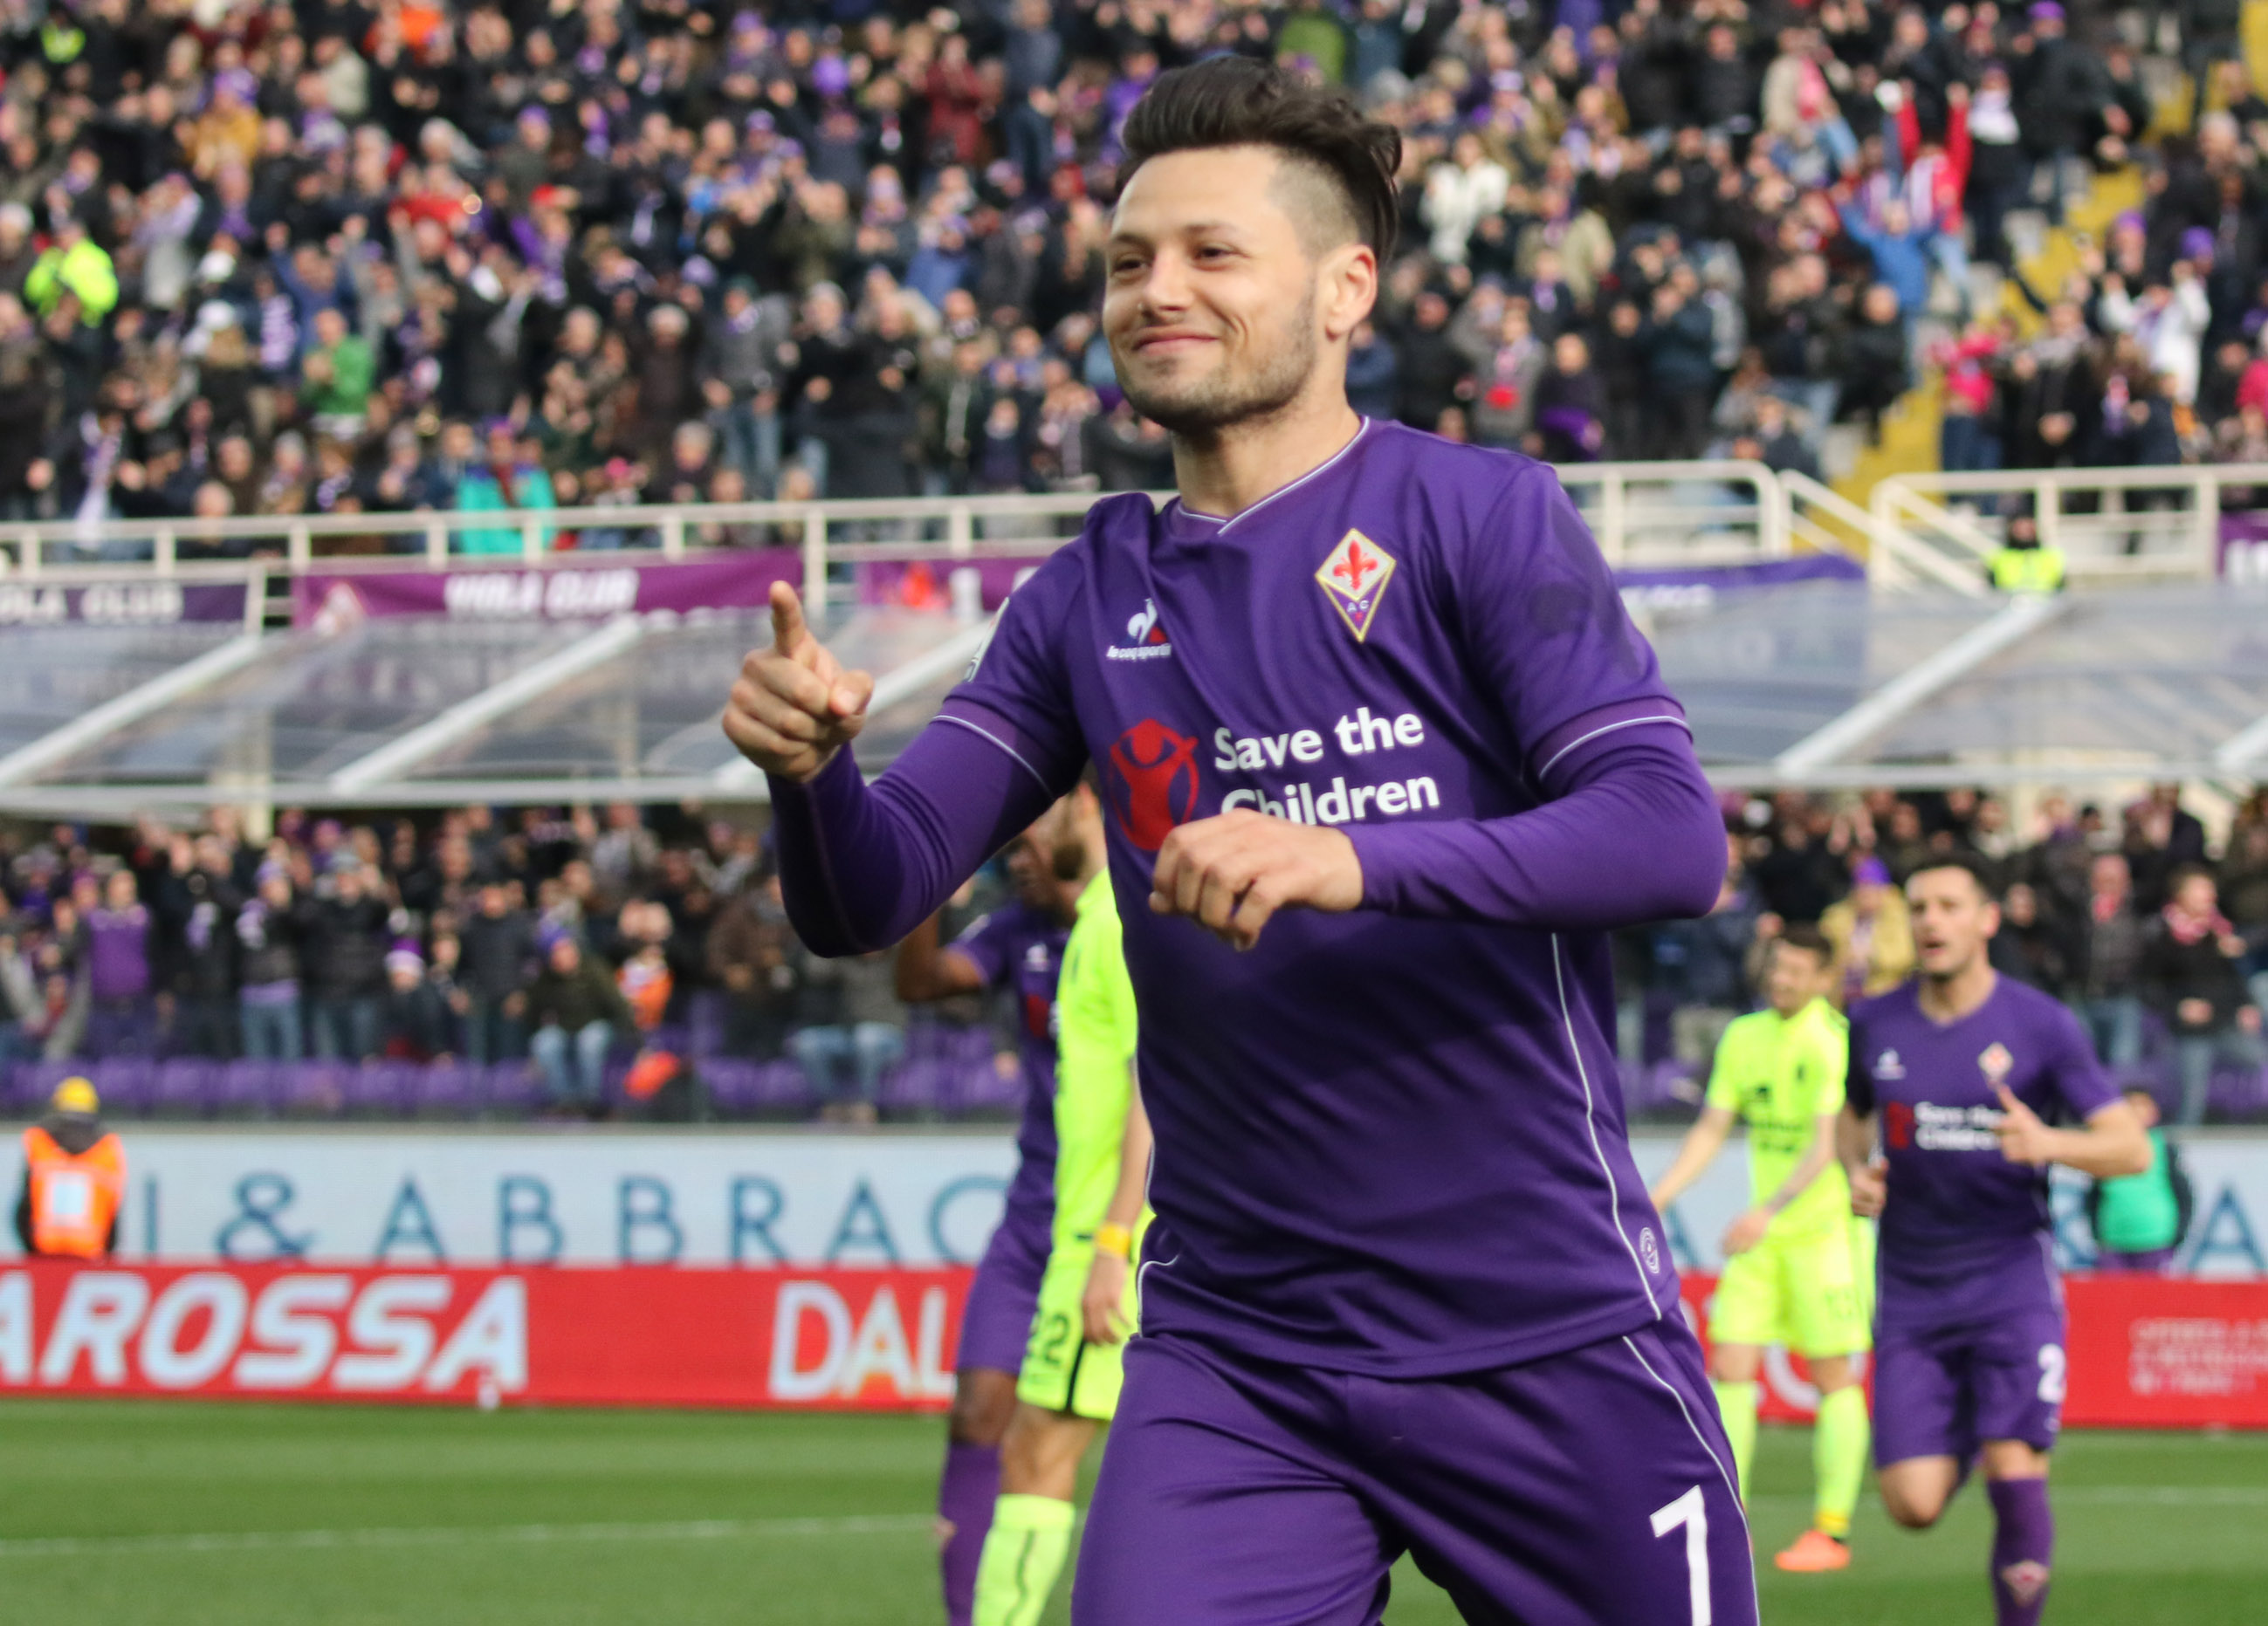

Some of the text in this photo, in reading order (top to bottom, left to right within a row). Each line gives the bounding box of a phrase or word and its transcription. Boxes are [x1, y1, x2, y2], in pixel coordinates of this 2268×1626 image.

[1214, 707, 1425, 771] Save the
[214, 1171, 316, 1262] &
[2037, 1343, 2066, 1403] 2
